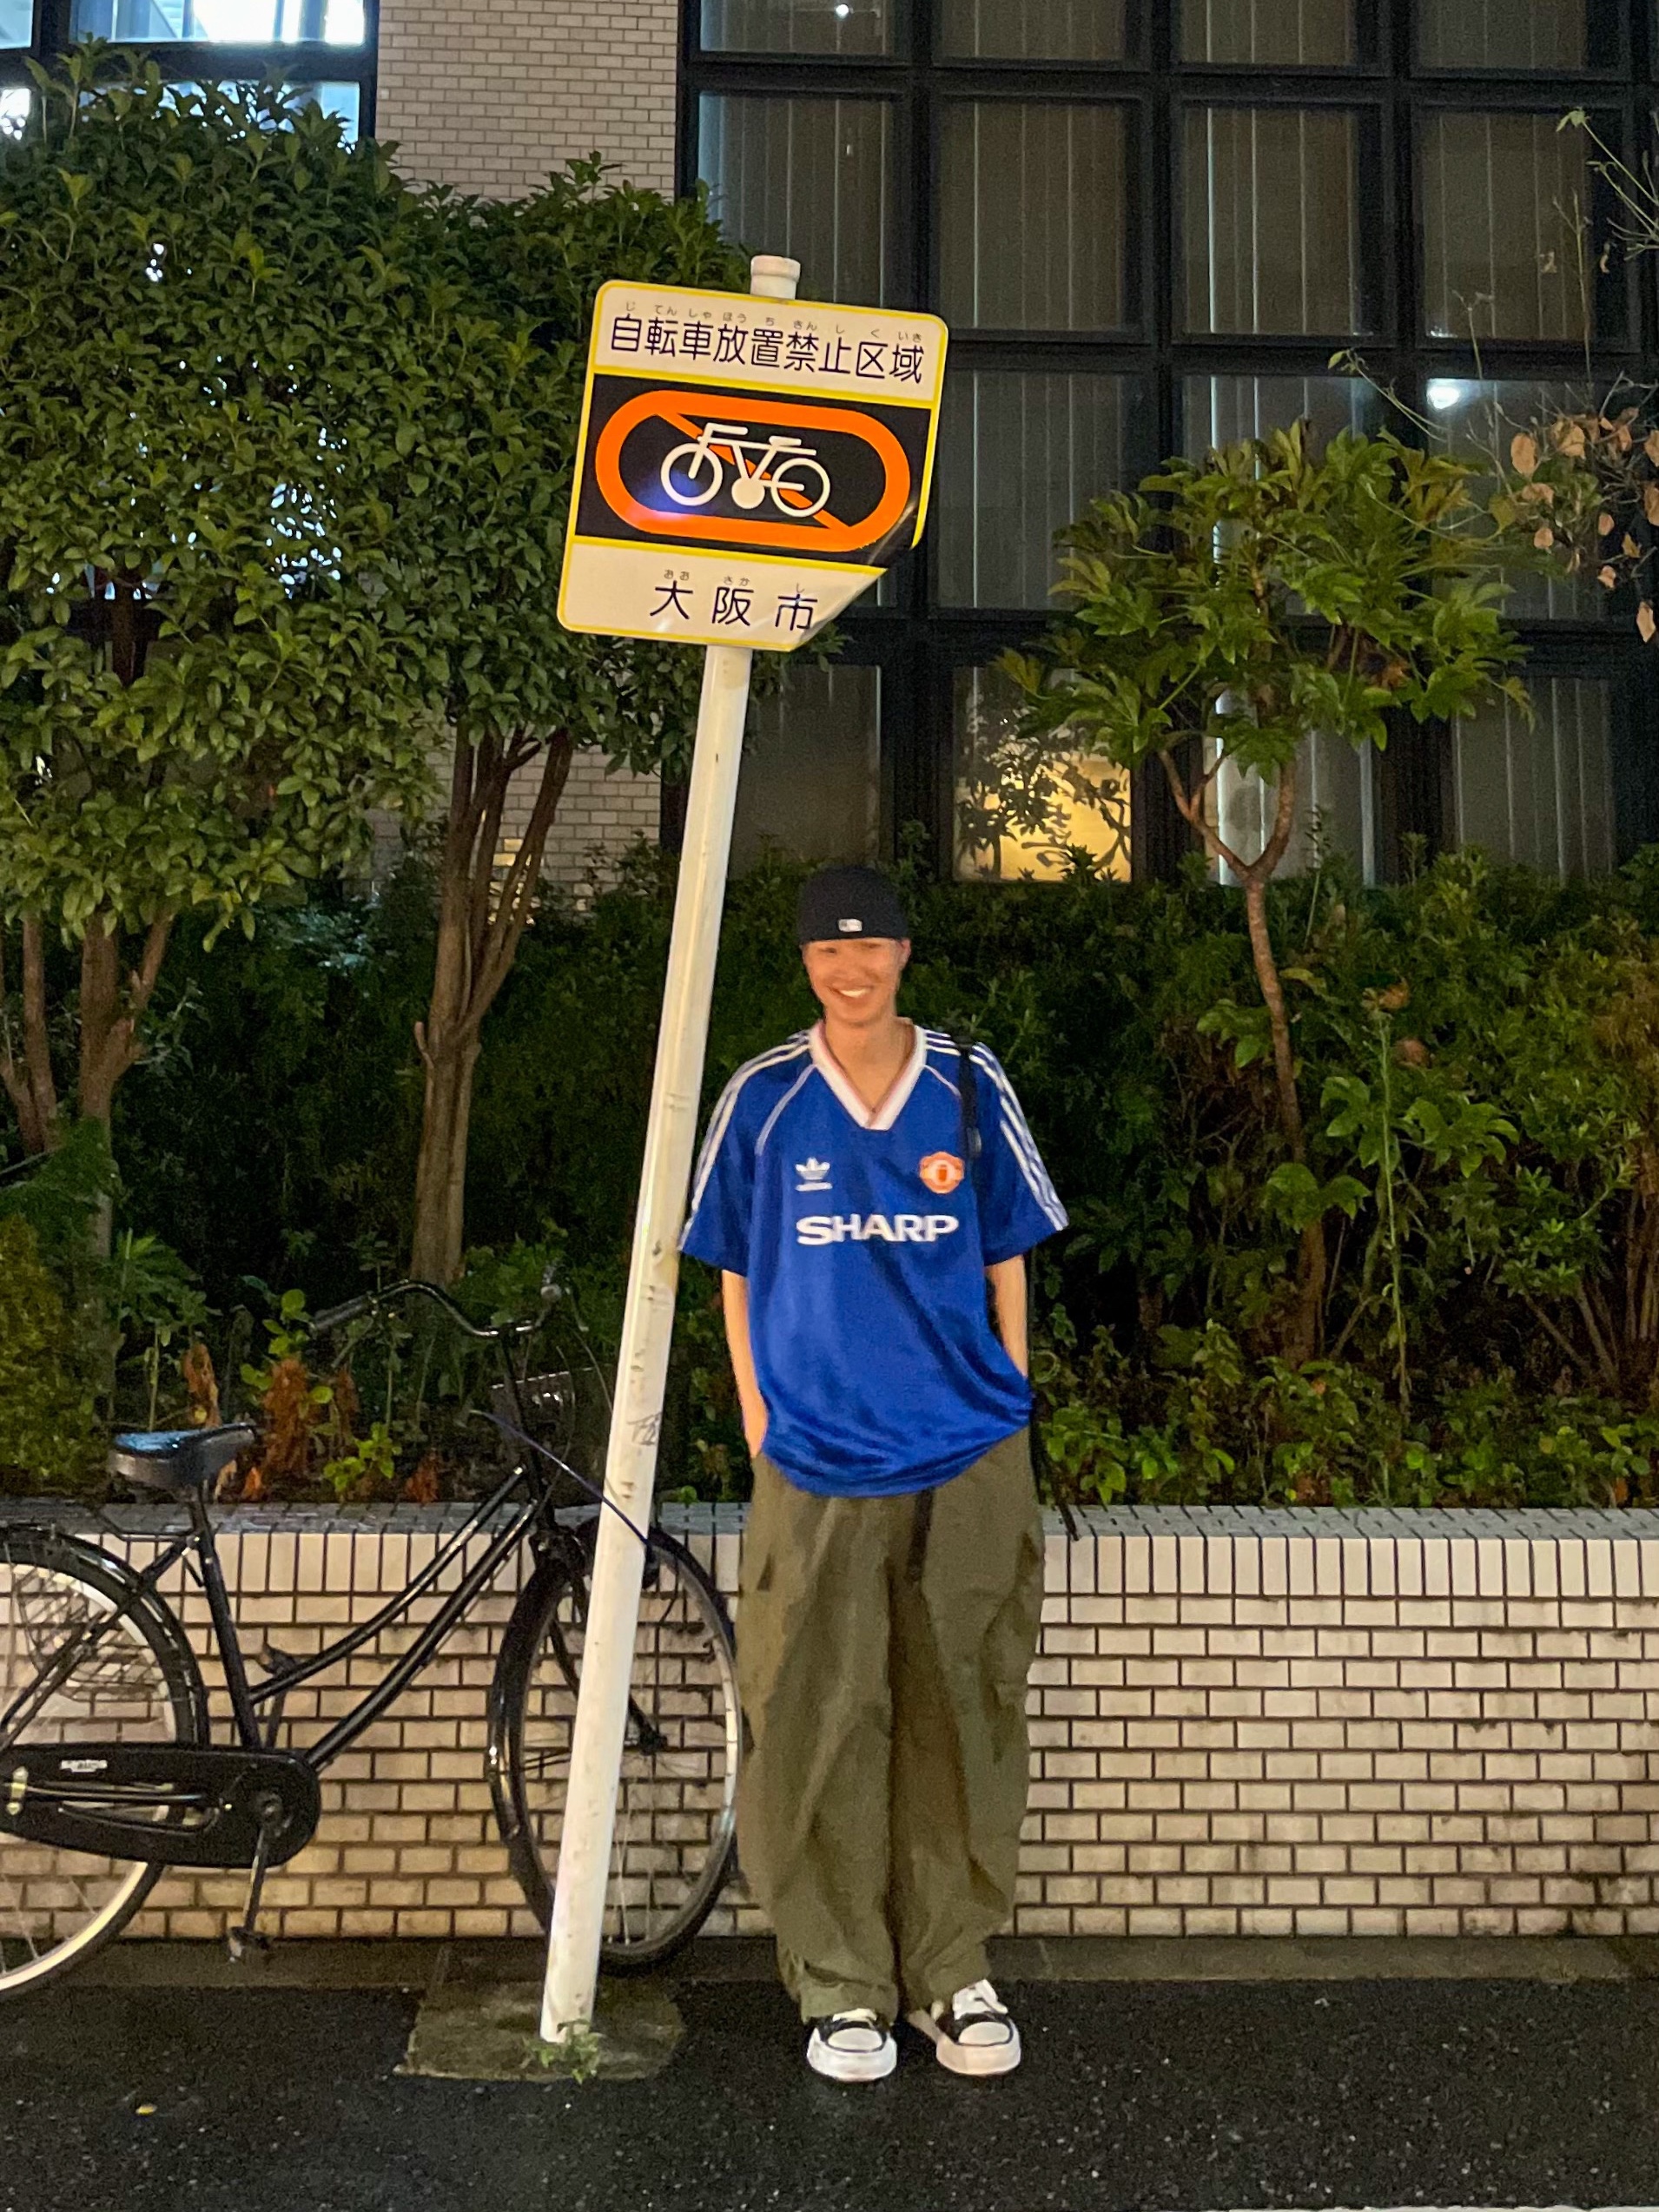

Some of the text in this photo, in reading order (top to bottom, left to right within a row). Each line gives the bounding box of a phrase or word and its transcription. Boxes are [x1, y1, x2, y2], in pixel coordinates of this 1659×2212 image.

[611, 314, 924, 384] 自転車放置禁止区域
[650, 580, 818, 631] 大阪市
[796, 1213, 959, 1245] SHARP
